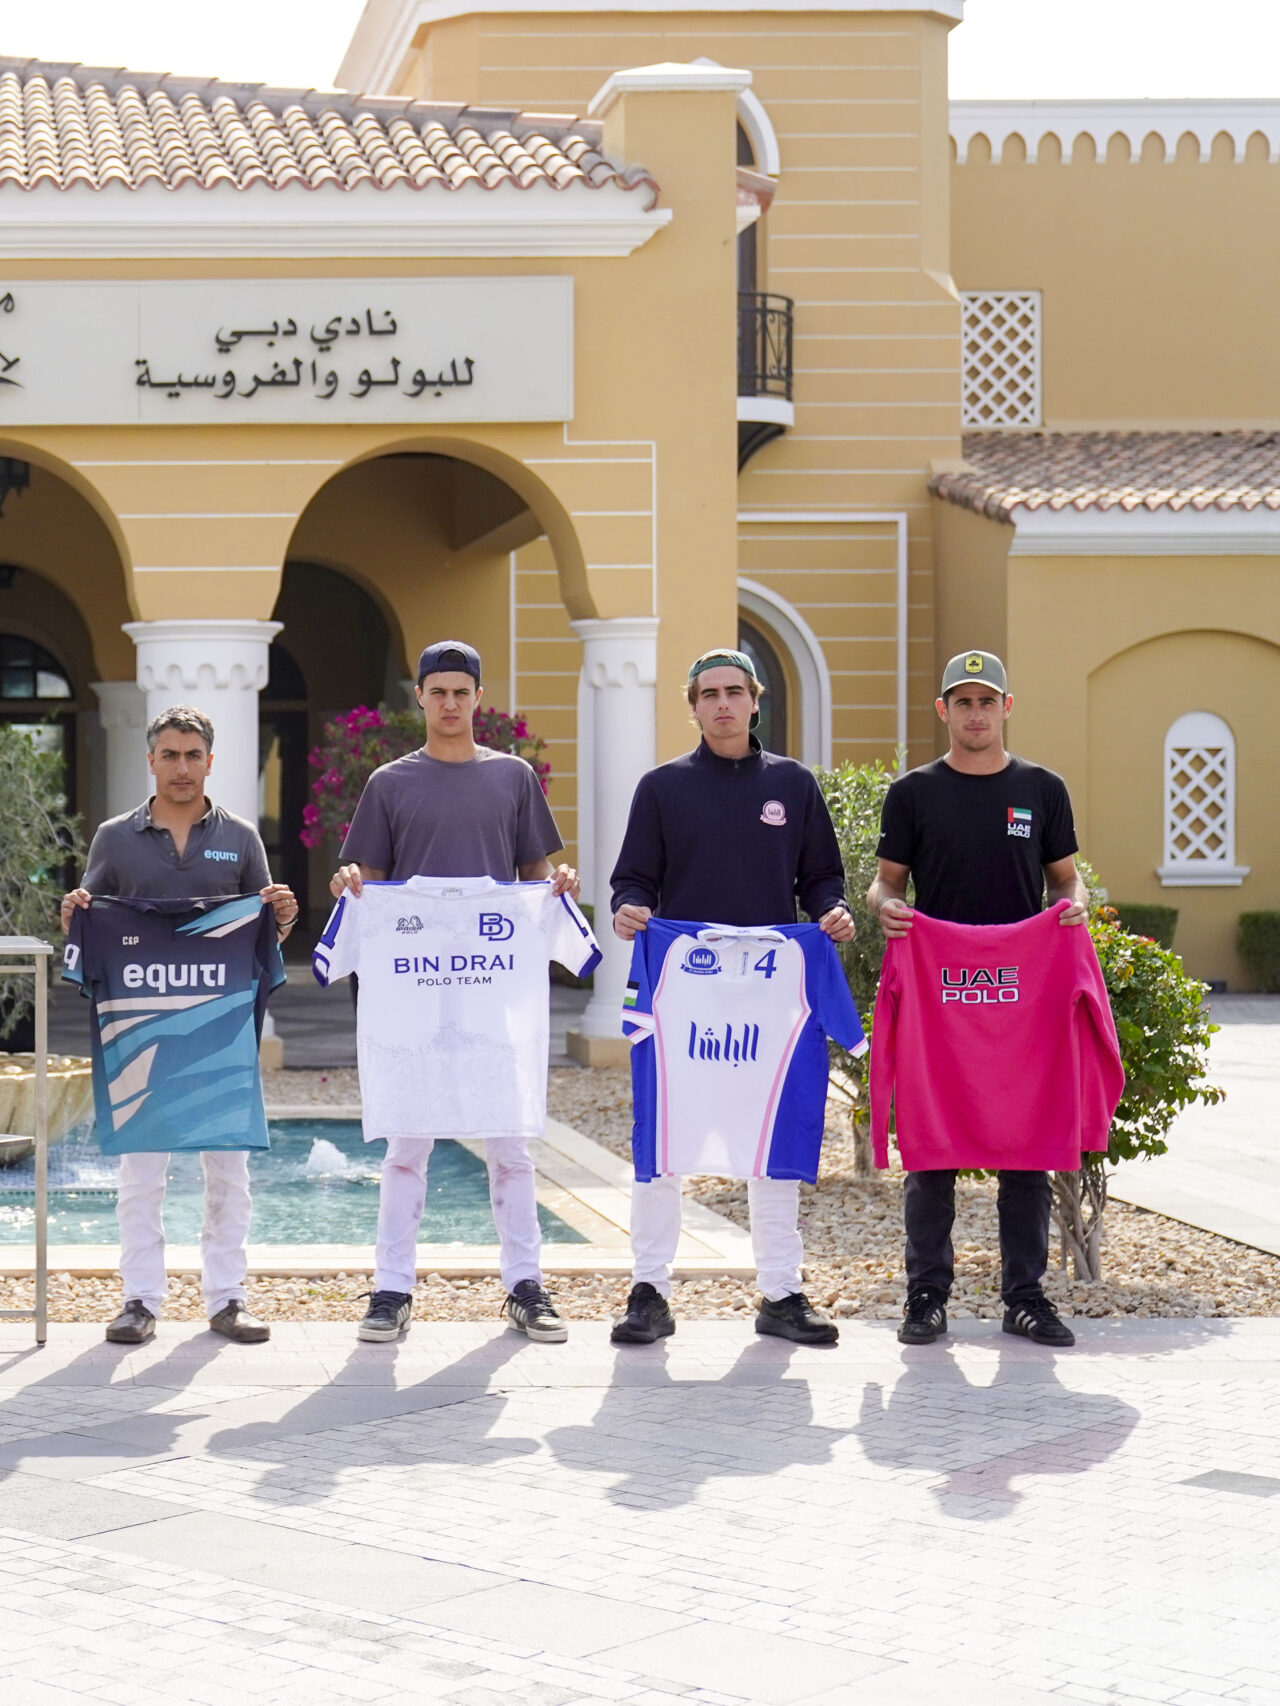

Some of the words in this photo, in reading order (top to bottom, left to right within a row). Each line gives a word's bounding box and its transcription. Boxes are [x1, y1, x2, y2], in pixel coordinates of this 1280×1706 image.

[215, 316, 298, 354] دبي
[310, 306, 398, 353] نادي
[134, 356, 340, 399] والفروسية
[1007, 822, 1031, 832] UAE
[1007, 830, 1031, 839] POLO
[204, 850, 238, 862] equiti
[394, 956, 439, 974] BIN
[451, 954, 514, 971] DRAI
[753, 949, 777, 979] 4
[122, 963, 226, 993] equiti
[417, 977, 452, 986] POLO
[458, 976, 492, 985] TEAM
[941, 966, 1019, 988] UAE
[942, 988, 1019, 1004] POLO
